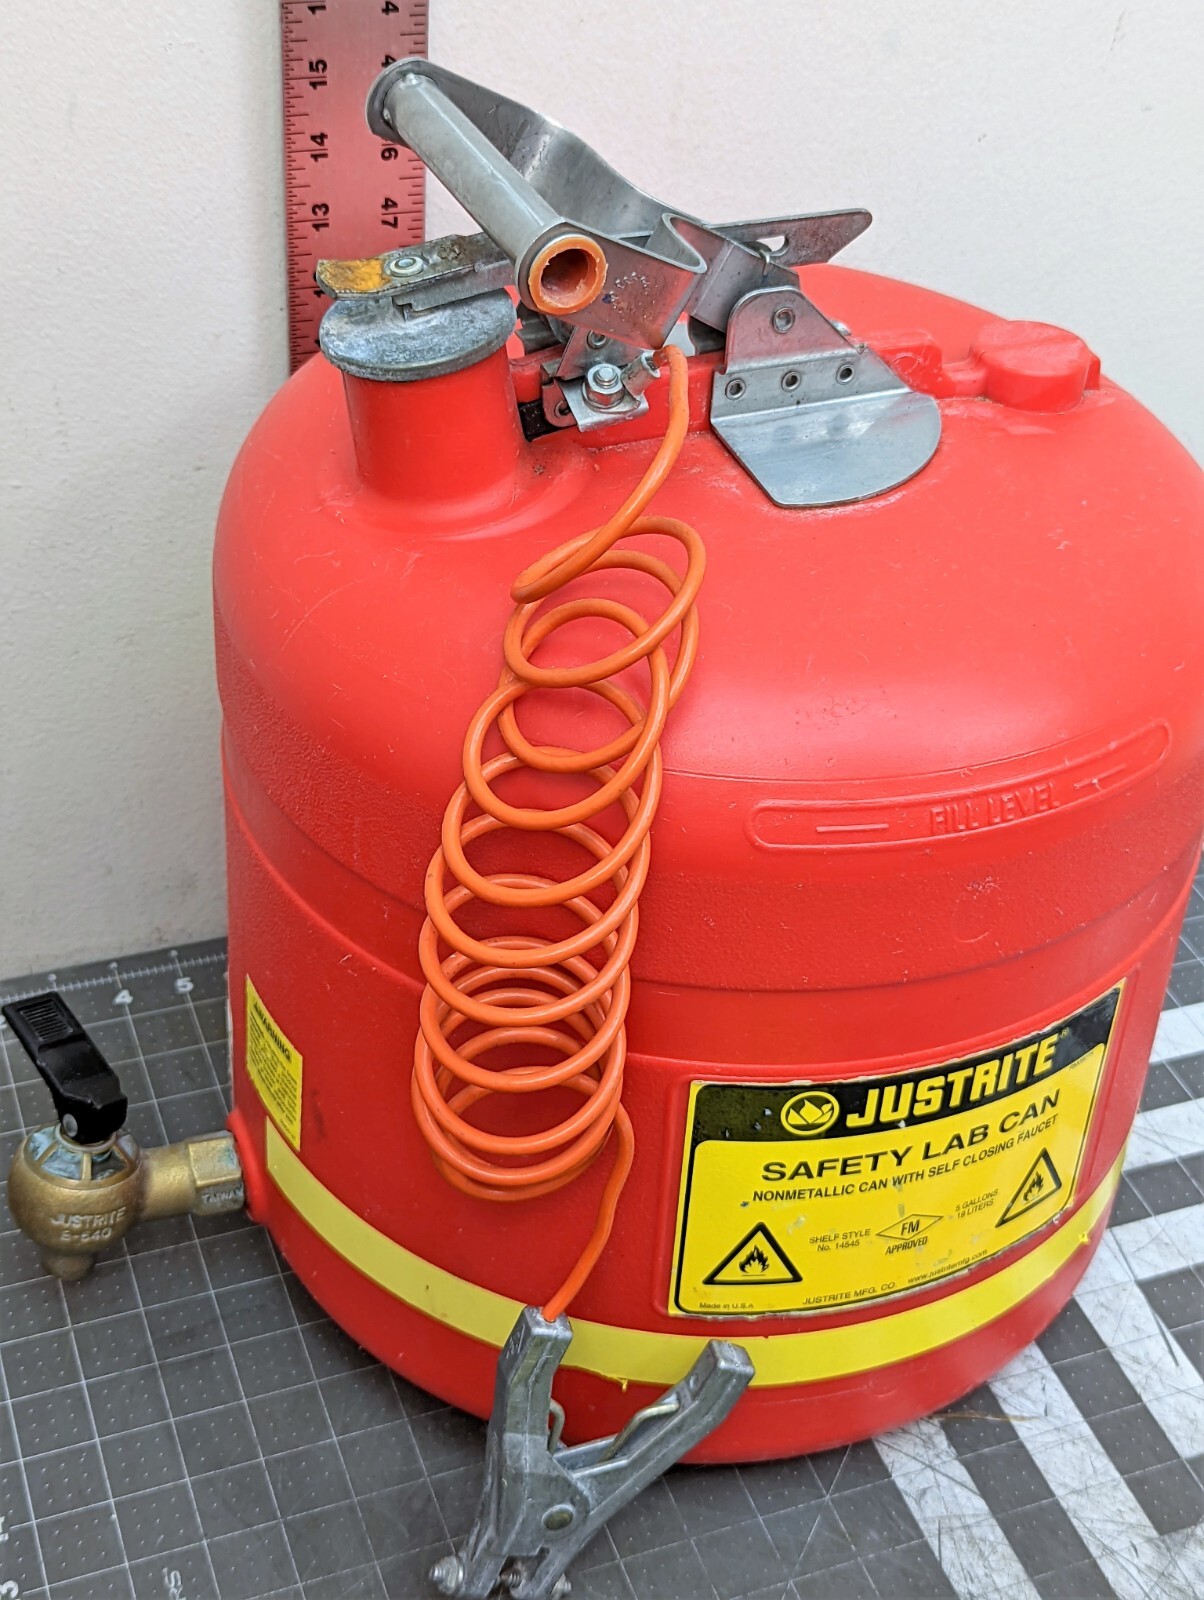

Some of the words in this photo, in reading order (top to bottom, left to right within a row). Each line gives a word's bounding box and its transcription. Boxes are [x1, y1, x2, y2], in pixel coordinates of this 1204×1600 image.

[308, 5, 326, 15] 1
[381, 1, 400, 15] 4
[381, 54, 396, 69] 4
[308, 59, 328, 90] 15
[310, 132, 328, 162] 14
[380, 147, 399, 161] 6
[311, 203, 330, 232] 13
[381, 197, 399, 229] 47
[930, 801, 979, 835] FILL
[987, 782, 1060, 825] LEVEL
[175, 976, 194, 993] 5
[113, 988, 134, 1005] 4
[761, 1145, 912, 1182] SAFETY
[921, 1123, 989, 1161] LAB
[998, 1088, 1061, 1133] CAN
[752, 1182, 855, 1202] NONMETALLIC
[858, 1177, 889, 1193] CAN
[891, 1168, 924, 1187] WITH
[927, 1159, 960, 1179] SELF
[962, 1137, 1015, 1168] CLOSING
[1016, 1112, 1059, 1147] FAUCET
[954, 1204, 960, 1212] 5
[962, 1188, 998, 1209] GALLONS
[967, 1198, 993, 1215] LITERS
[50, 1206, 127, 1229] JUSTRITE
[808, 1233, 841, 1244] SHELF
[841, 1228, 872, 1240] STYLE
[900, 1219, 920, 1236] FM
[816, 1243, 832, 1252] No.
[835, 1239, 860, 1250] 14545
[884, 1236, 929, 1255] APPROVED
[802, 1292, 851, 1305] JUSTRITE
[853, 1286, 878, 1296] MFG.
